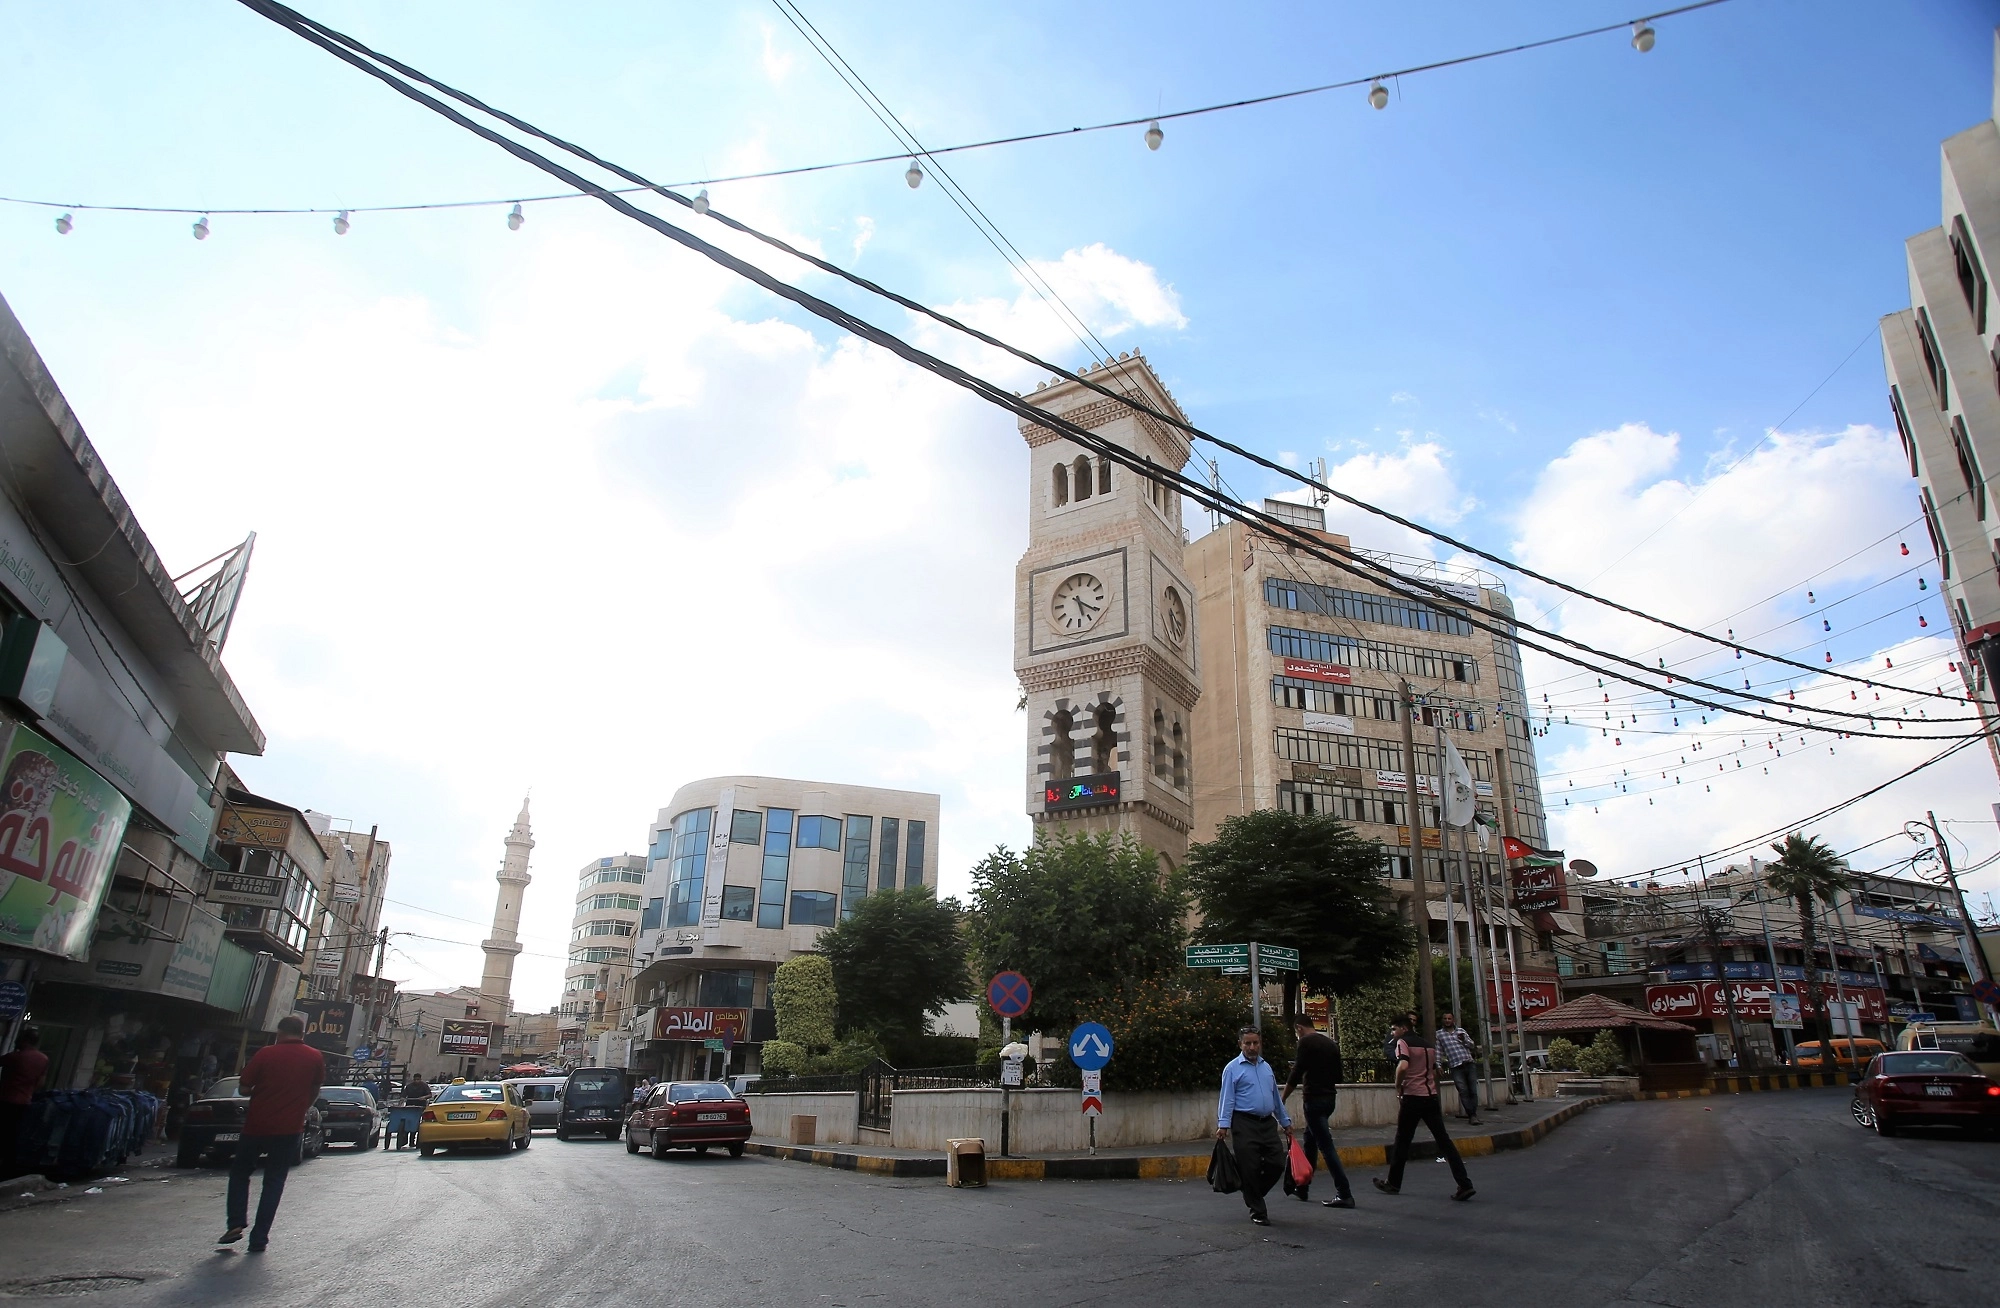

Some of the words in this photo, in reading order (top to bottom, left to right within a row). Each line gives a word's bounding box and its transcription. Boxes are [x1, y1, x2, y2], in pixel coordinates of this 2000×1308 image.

[217, 874, 272, 887] WESTERN
[232, 884, 271, 894] UNION
[243, 896, 274, 905] TRANSFER
[1194, 947, 1223, 955] الشهيد
[1261, 946, 1283, 956] العروبة
[1651, 992, 1697, 1013] الحواري
[306, 1009, 345, 1038] بسام
[665, 1011, 714, 1035] الملاح
